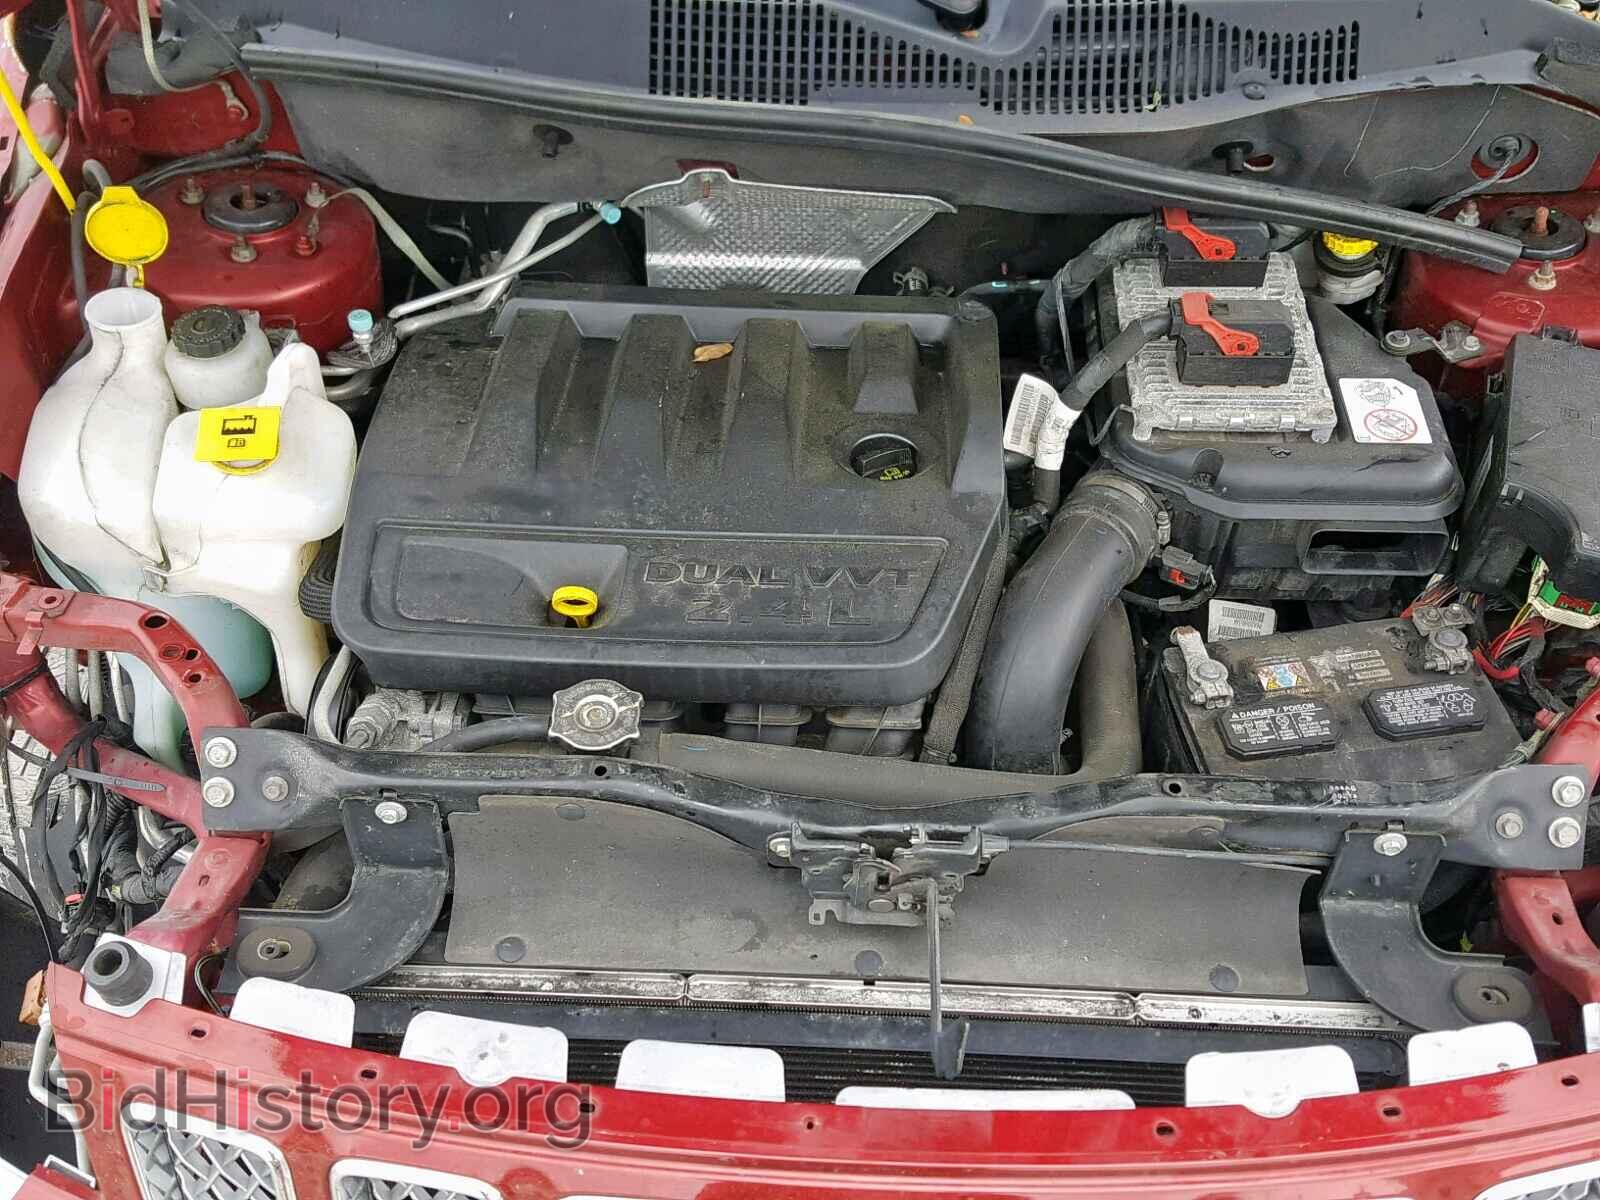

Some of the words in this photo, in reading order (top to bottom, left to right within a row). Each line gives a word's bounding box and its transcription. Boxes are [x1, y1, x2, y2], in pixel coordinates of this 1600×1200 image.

[643, 561, 792, 588] DUAL
[804, 564, 918, 590] VVT
[685, 594, 872, 626] 2.4L
[1239, 708, 1275, 718] DANGER
[1282, 703, 1316, 713] POISON
